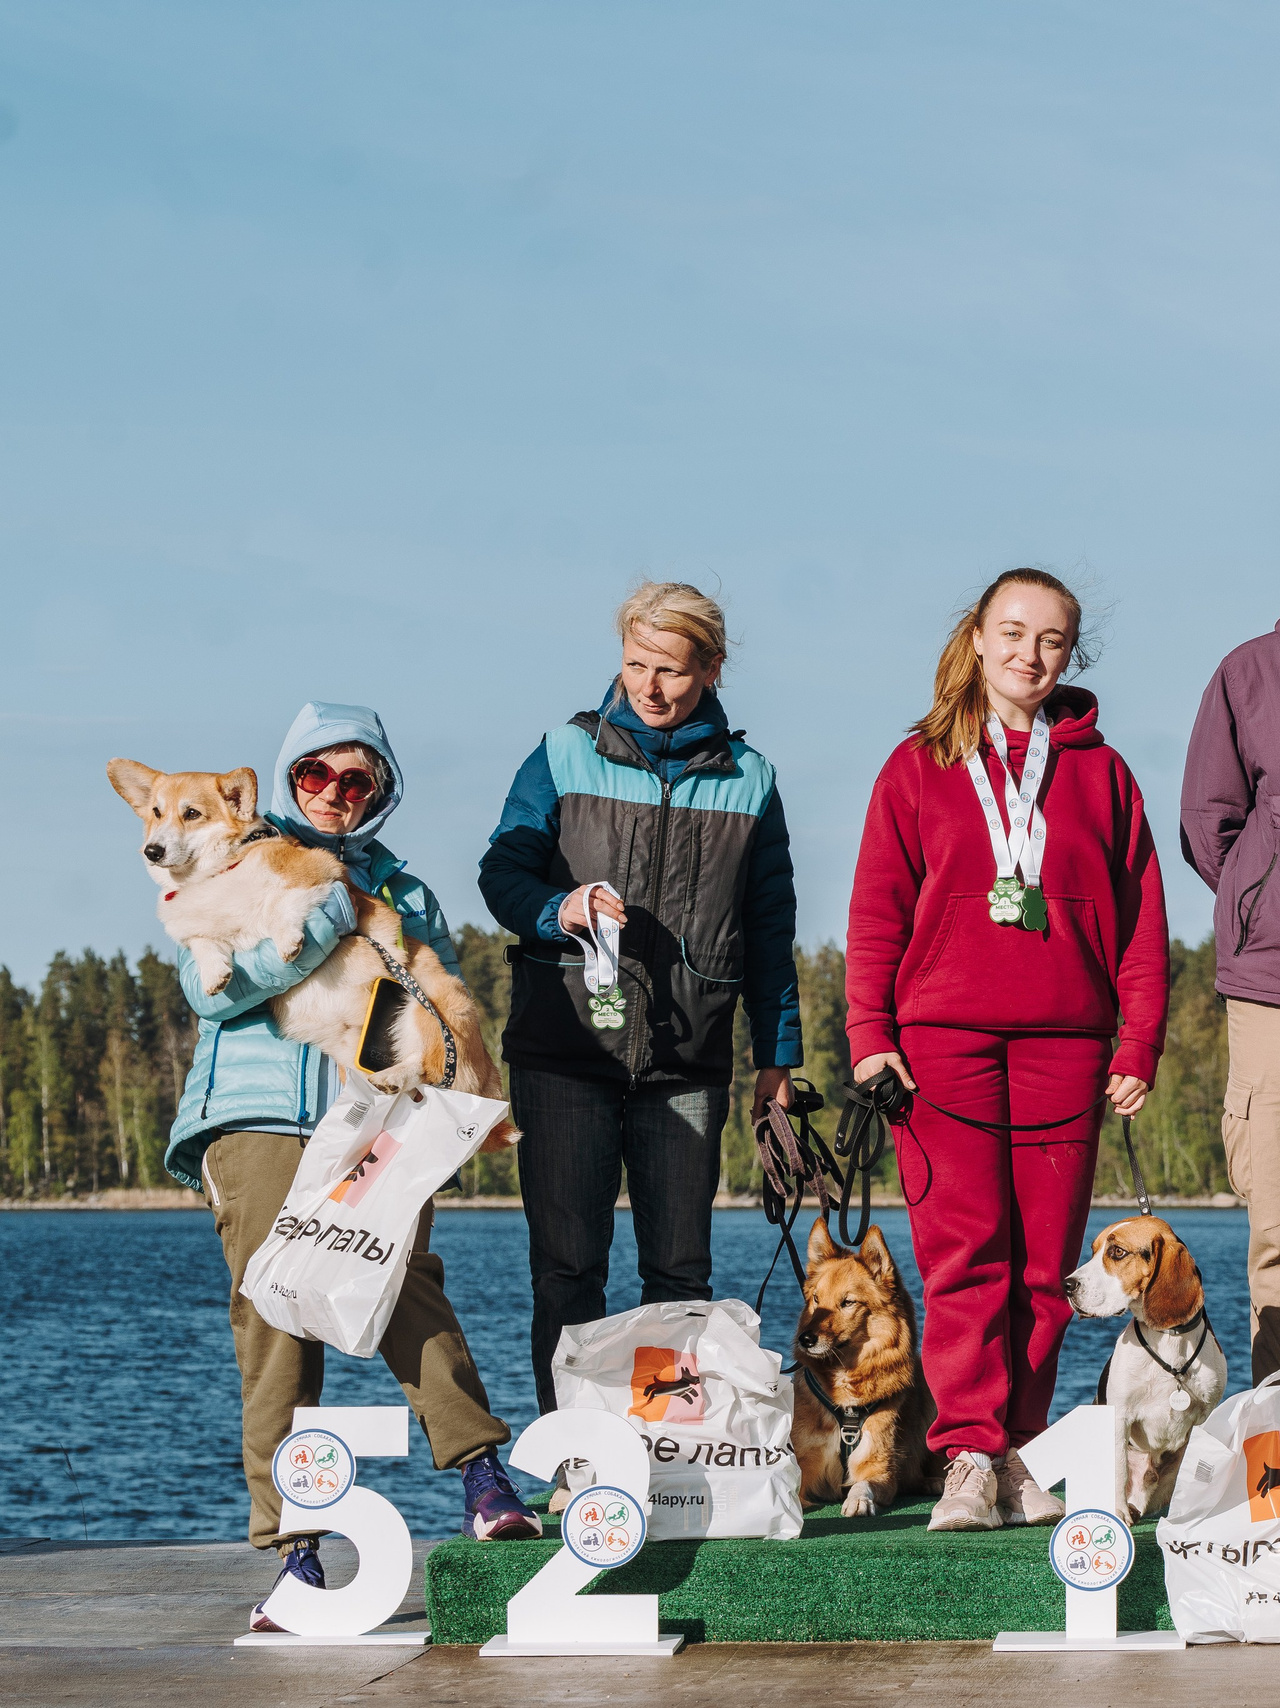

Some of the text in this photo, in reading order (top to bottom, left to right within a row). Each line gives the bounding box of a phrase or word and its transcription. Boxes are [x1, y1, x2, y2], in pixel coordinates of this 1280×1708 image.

[261, 1406, 413, 1637] 5
[508, 1407, 659, 1643] 2
[647, 1492, 705, 1508] 4lapy.ru
[1017, 1405, 1117, 1639] 1
